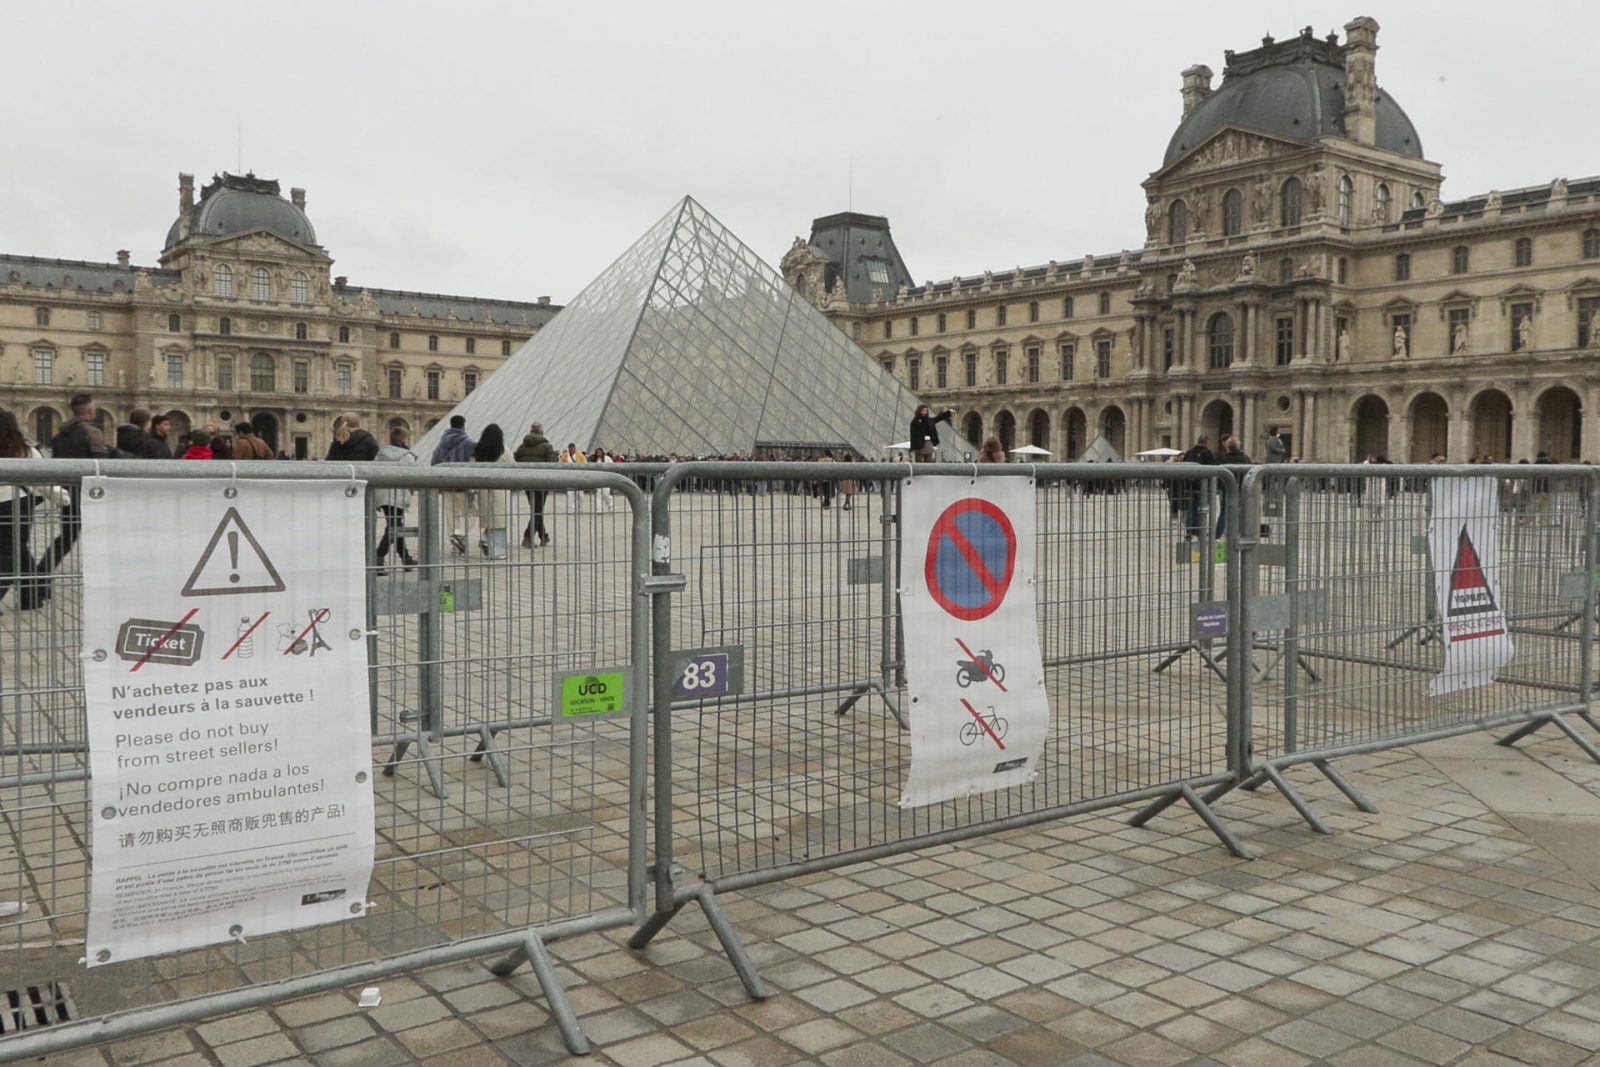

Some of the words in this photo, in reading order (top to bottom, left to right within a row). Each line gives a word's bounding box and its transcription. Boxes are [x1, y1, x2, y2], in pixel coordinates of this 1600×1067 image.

[135, 632, 186, 650] Ticket
[112, 683, 199, 699] N'achetez
[204, 680, 234, 695] pas
[239, 676, 268, 688] aux
[579, 683, 607, 696] UCD
[683, 661, 716, 689] 83
[113, 701, 195, 720] vendeurs
[201, 699, 210, 712] à
[215, 697, 230, 710] la
[235, 692, 304, 708] sauvette
[310, 689, 314, 701] !
[116, 731, 174, 748] Please
[180, 728, 200, 742] do
[207, 725, 234, 738] not
[239, 721, 269, 736] buy
[117, 753, 160, 769] from
[166, 747, 215, 763] street
[219, 738, 279, 757] sellers!
[119, 782, 151, 800] ¡No
[158, 775, 223, 794] compre
[229, 769, 267, 783] nada
[273, 768, 281, 778] a
[287, 764, 309, 776] los
[118, 795, 221, 817] vendedores
[226, 779, 325, 804] ambulantes!
[118, 804, 346, 848] 请勿购买无照商贩兜售的产品!
